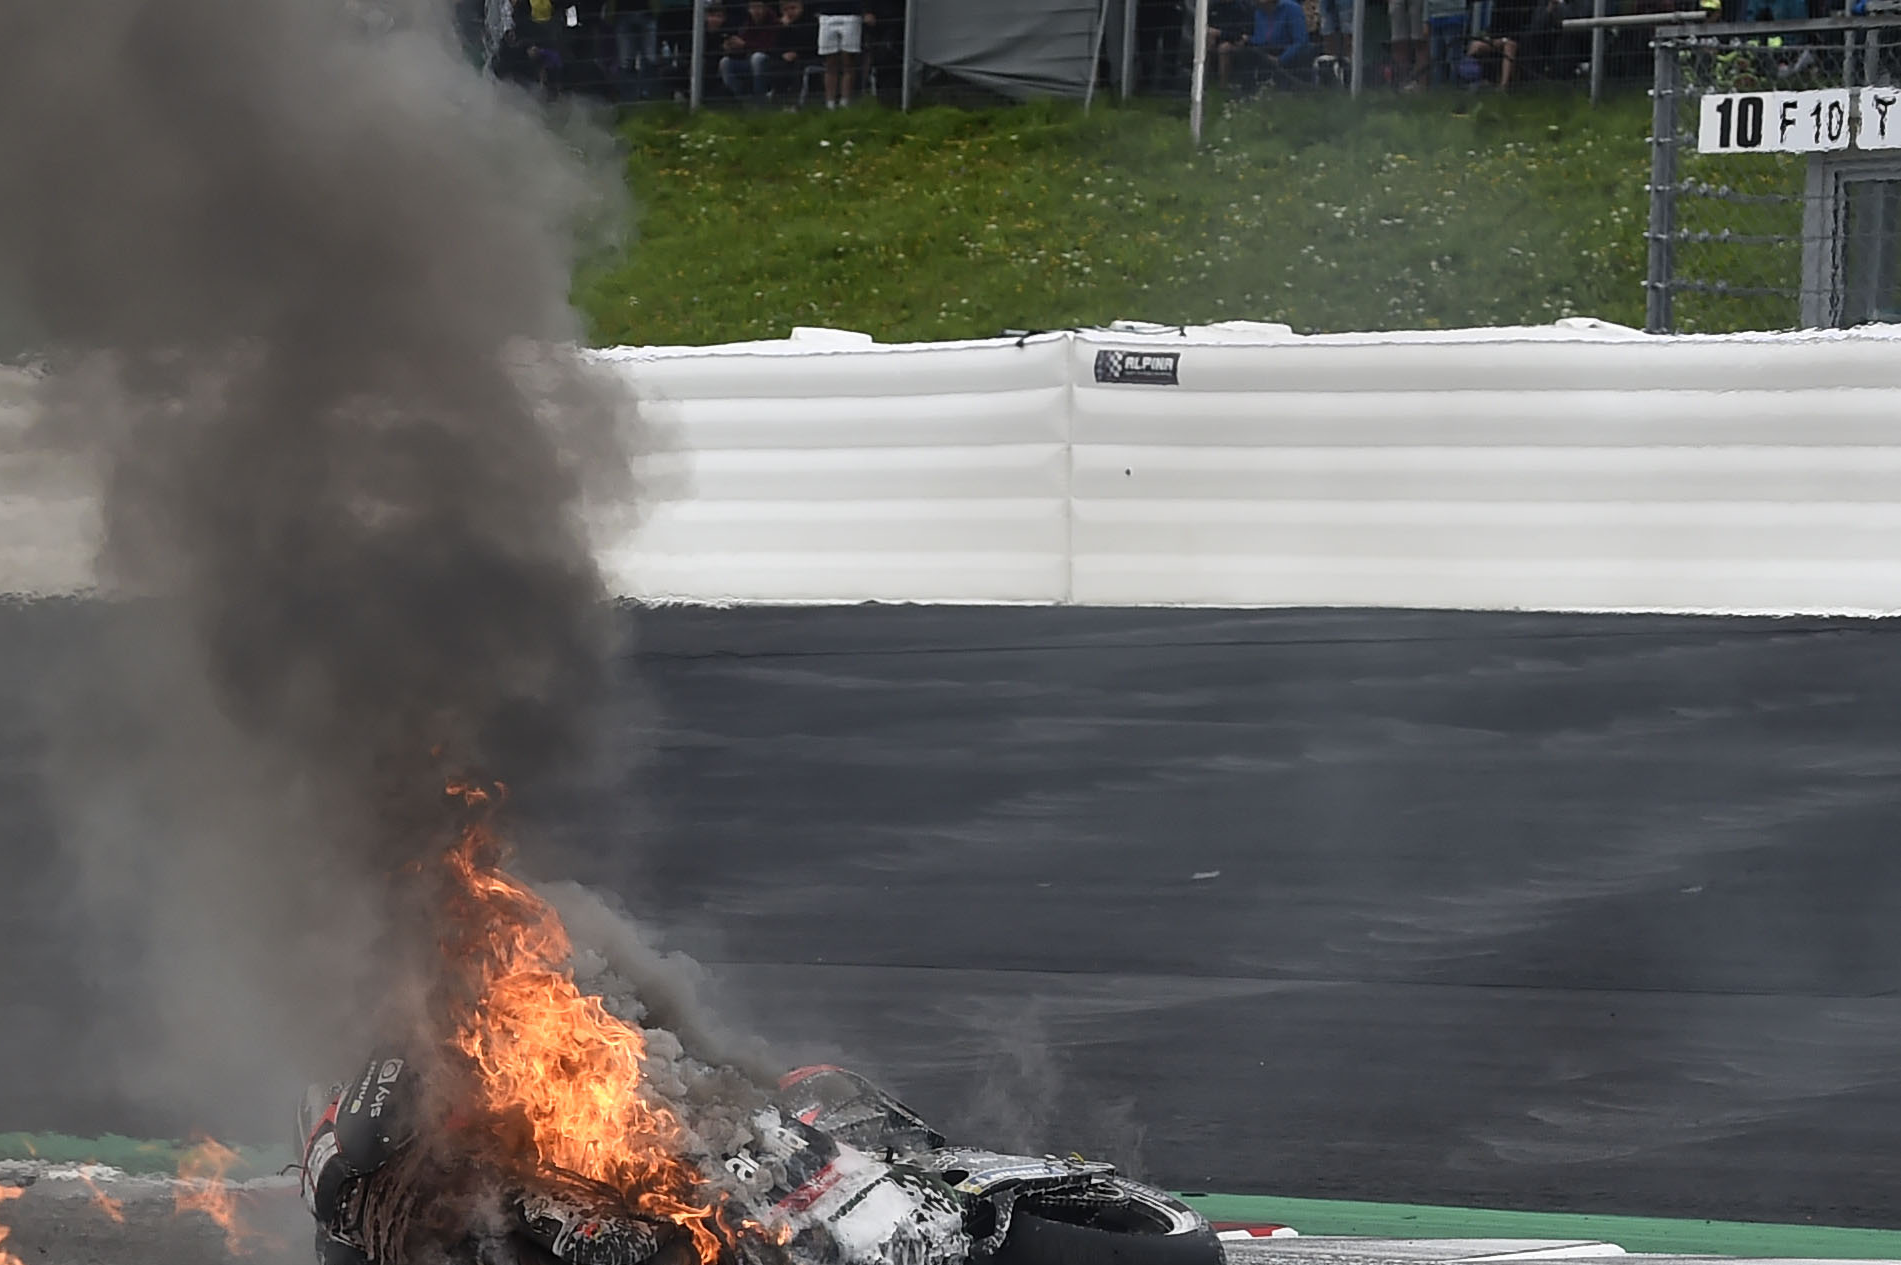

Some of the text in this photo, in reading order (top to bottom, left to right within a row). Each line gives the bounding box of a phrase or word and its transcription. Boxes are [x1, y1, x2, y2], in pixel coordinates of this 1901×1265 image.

[1716, 96, 1764, 148] 10
[1779, 101, 1798, 144] F
[1810, 100, 1844, 144] 10
[370, 1085, 391, 1118] sky
